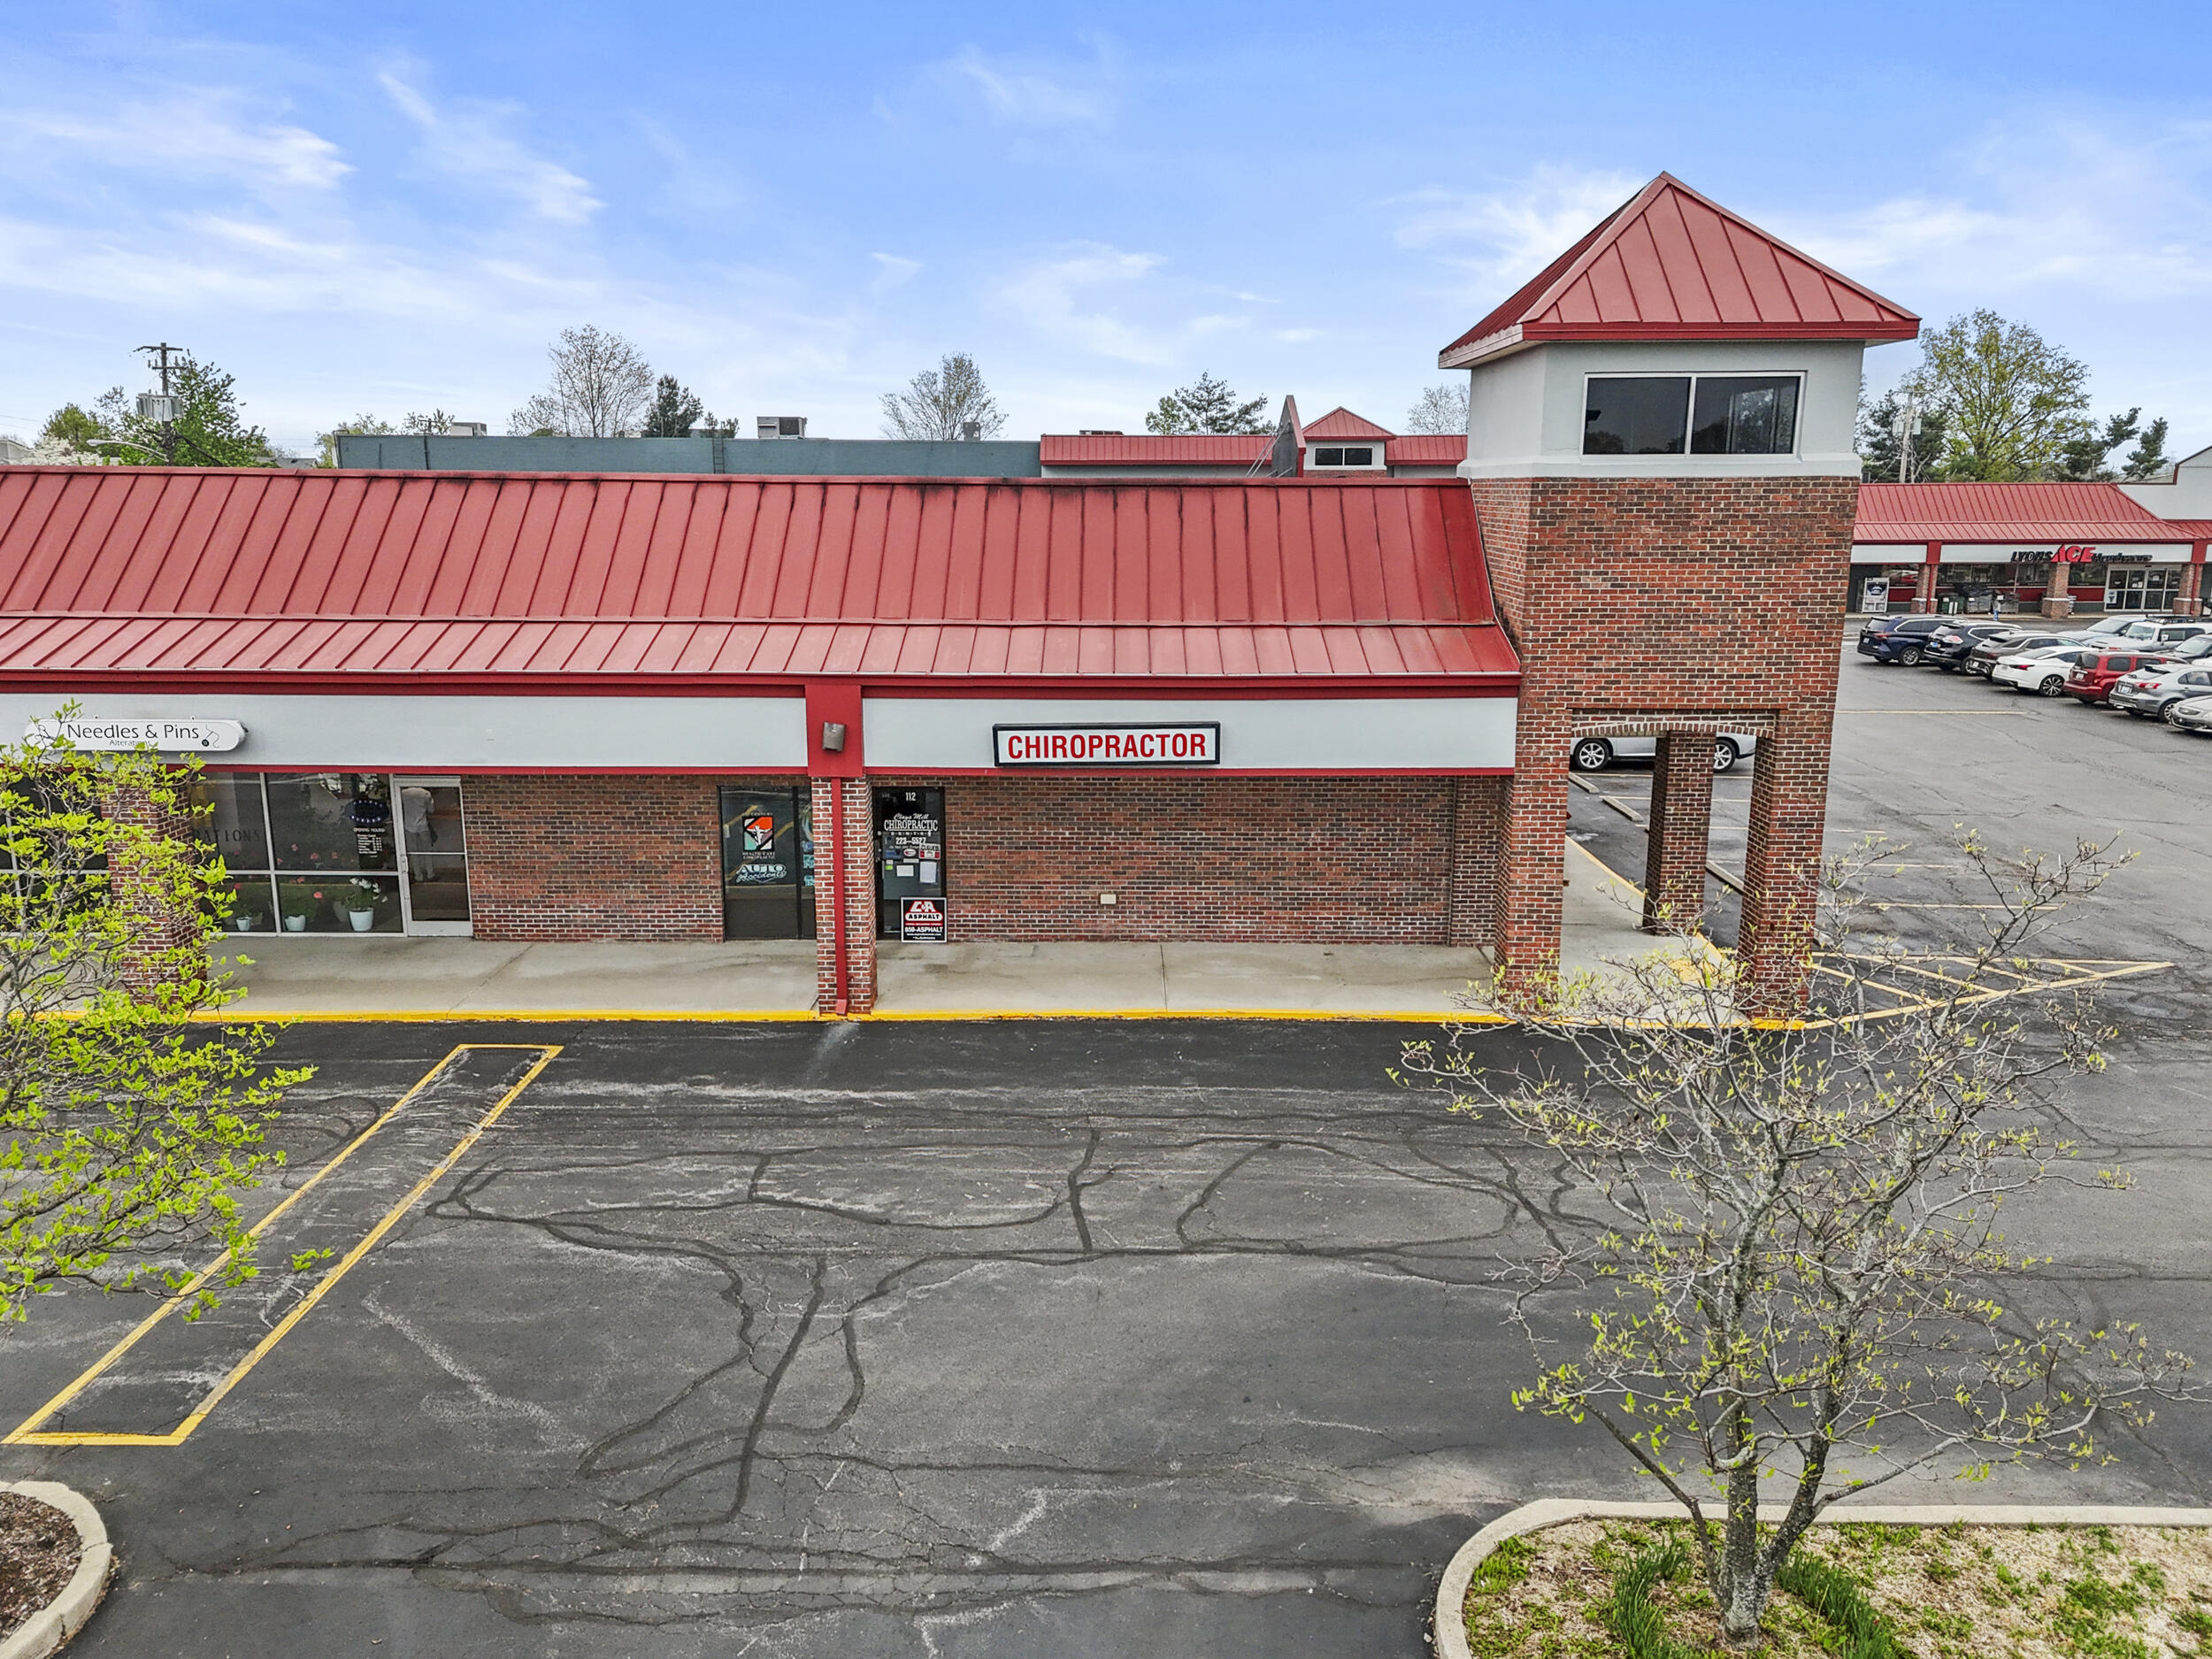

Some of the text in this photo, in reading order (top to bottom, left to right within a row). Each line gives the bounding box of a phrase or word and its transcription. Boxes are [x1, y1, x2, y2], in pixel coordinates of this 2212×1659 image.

[2011, 550, 2053, 563] LYONS
[2050, 544, 2096, 563] ACE
[67, 724, 199, 739] Needles & Pins
[1008, 733, 1206, 759] CHIROPRACTOR
[905, 792, 916, 801] 112
[884, 819, 938, 831] CHIROPRACTIC
[736, 864, 786, 874] AUTO
